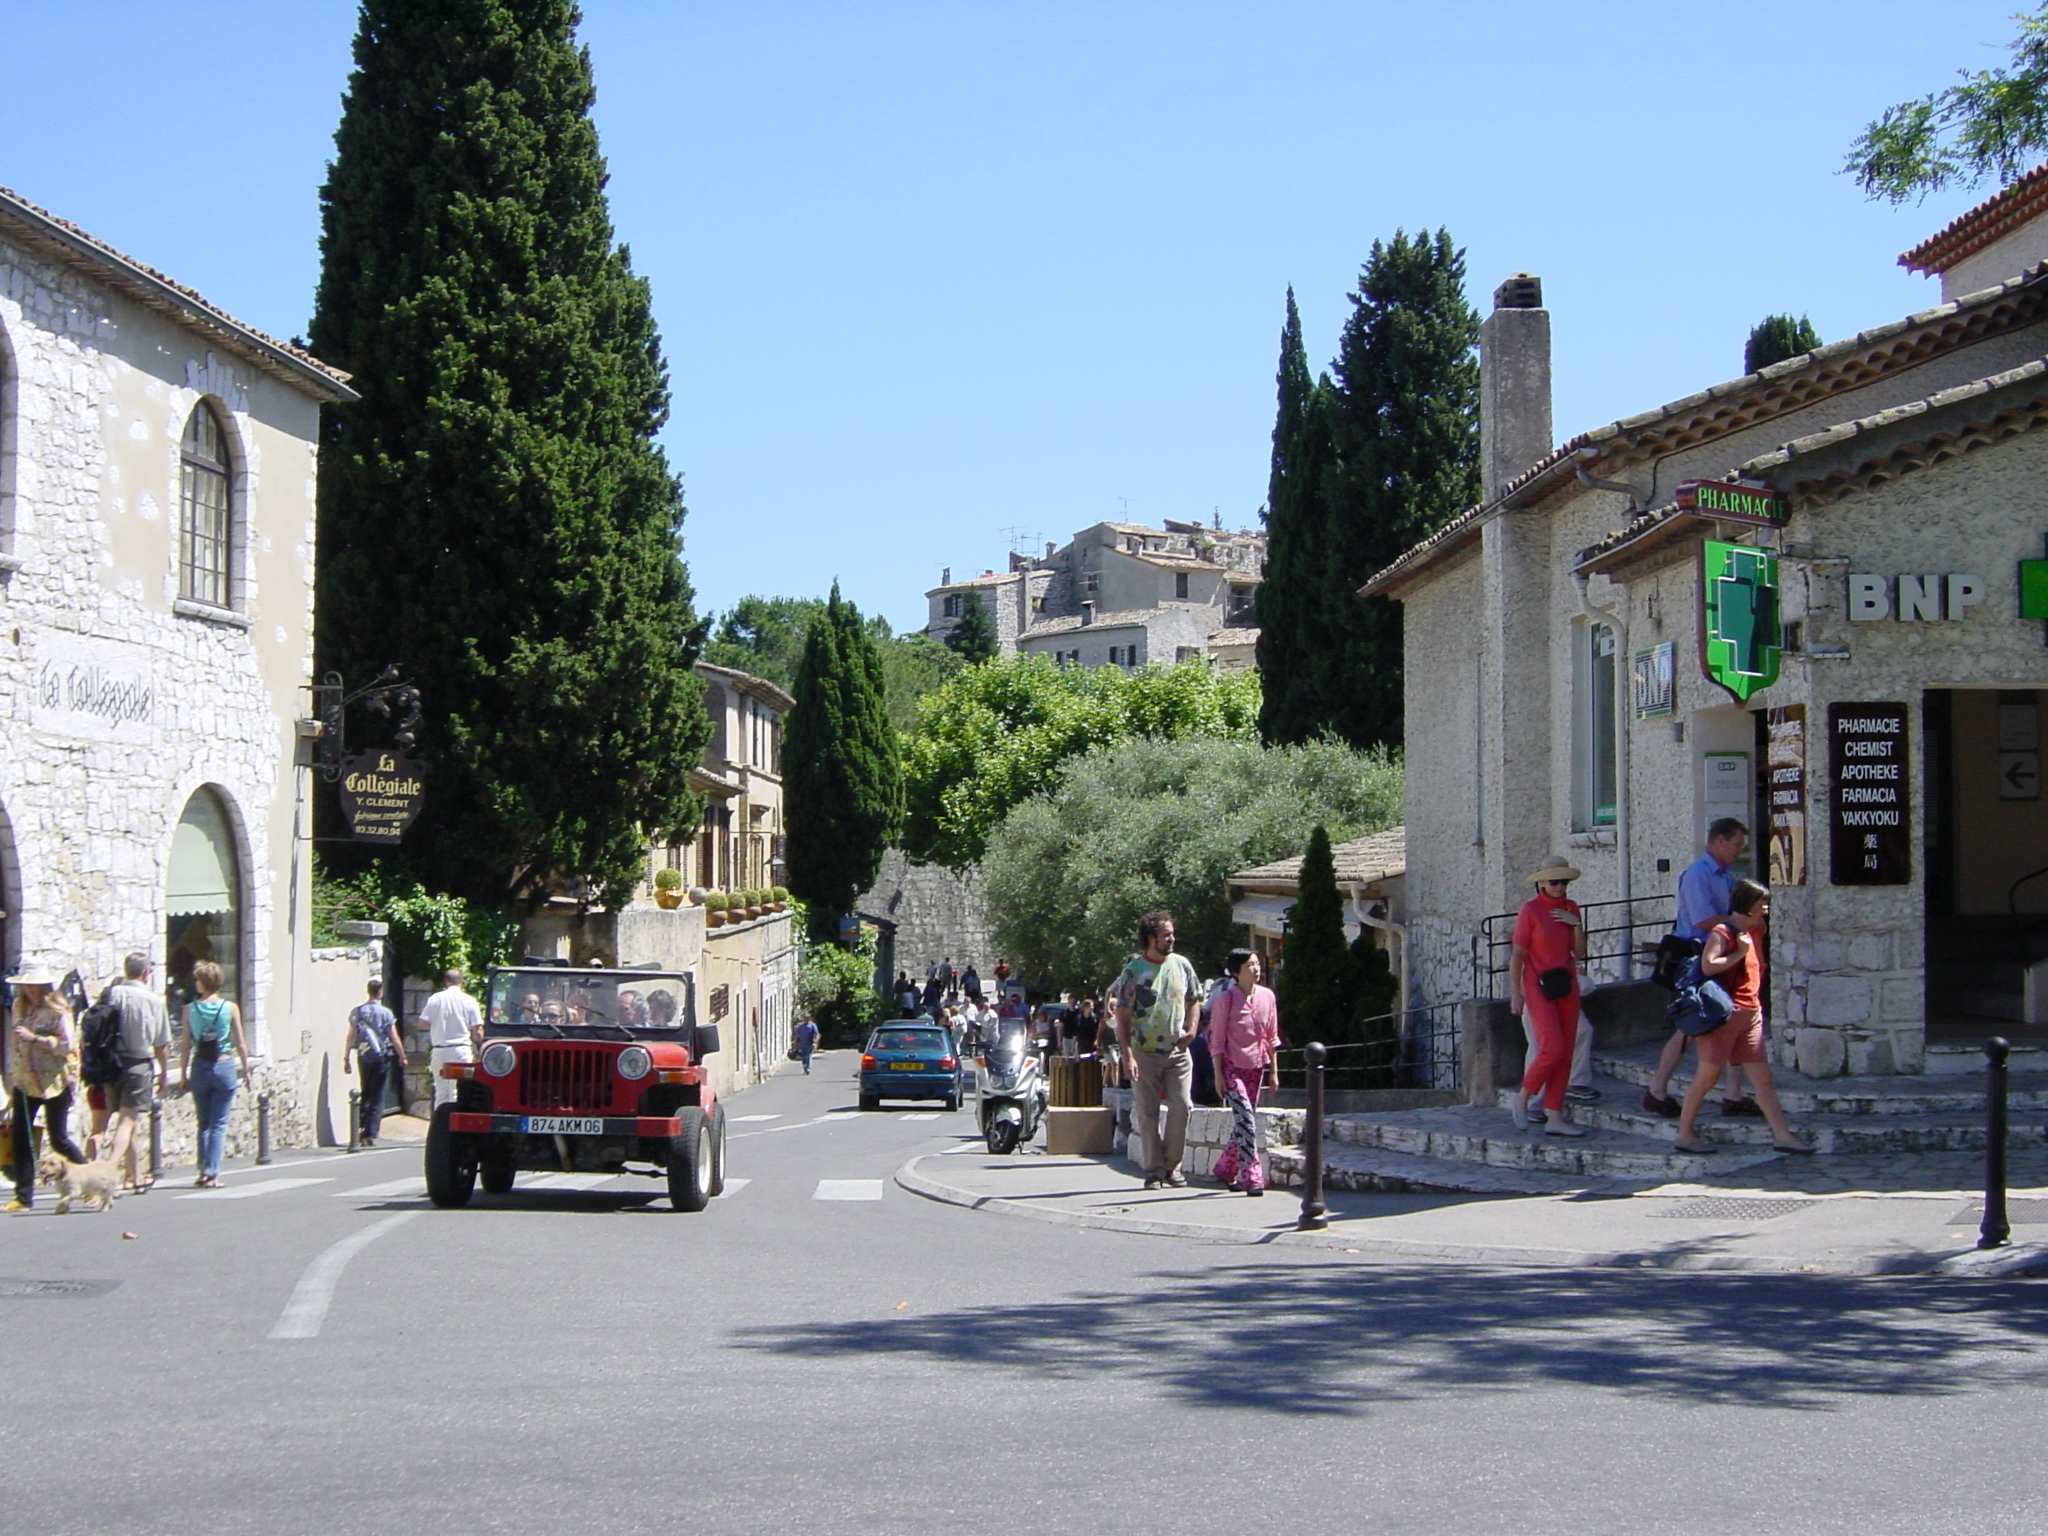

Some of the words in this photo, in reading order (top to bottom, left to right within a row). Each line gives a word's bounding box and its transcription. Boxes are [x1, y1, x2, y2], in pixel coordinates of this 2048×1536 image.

[1697, 487, 1785, 520] PHARMACIE
[1849, 574, 1984, 621] BNP
[1837, 718, 1900, 734] PHARMACIE
[1844, 741, 1893, 757] CHEMIST
[376, 754, 395, 772] La
[1841, 764, 1899, 781] APOTHEKE
[1841, 788, 1897, 804] FARMACIA
[1841, 811, 1900, 826] YAKKYOKU
[531, 1118, 556, 1132] 874
[557, 1118, 582, 1133] AKM
[584, 1119, 601, 1134] 06
